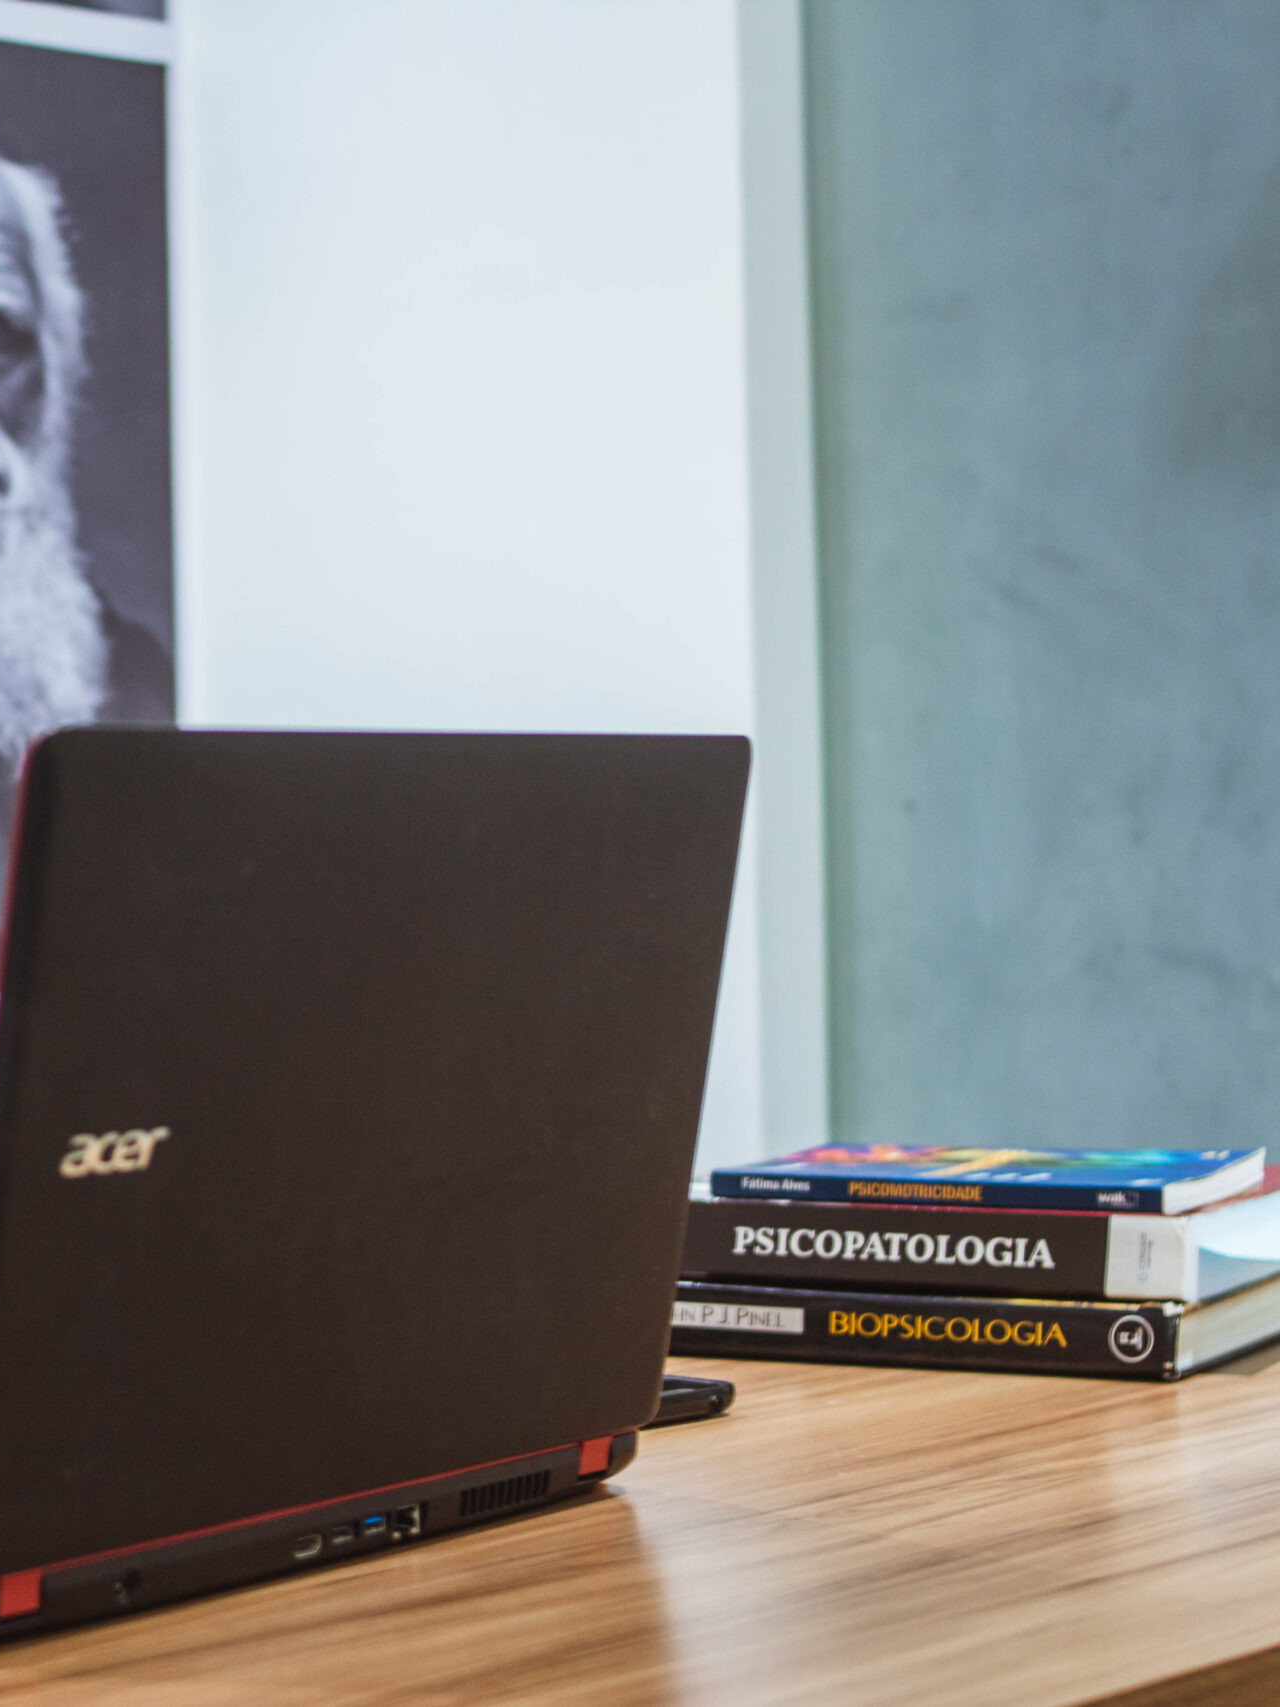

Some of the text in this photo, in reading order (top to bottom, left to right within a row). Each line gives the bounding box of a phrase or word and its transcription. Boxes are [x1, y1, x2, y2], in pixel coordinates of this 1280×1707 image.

[60, 1126, 171, 1179] acer
[782, 1178, 811, 1192] Alves
[848, 1181, 983, 1201] PSICOMOTRICIDADE
[732, 1225, 1055, 1269] PSICOPATOLOGIA
[736, 1307, 786, 1328] PINEL
[828, 1310, 1068, 1348] BIOPSICOLOGIA
